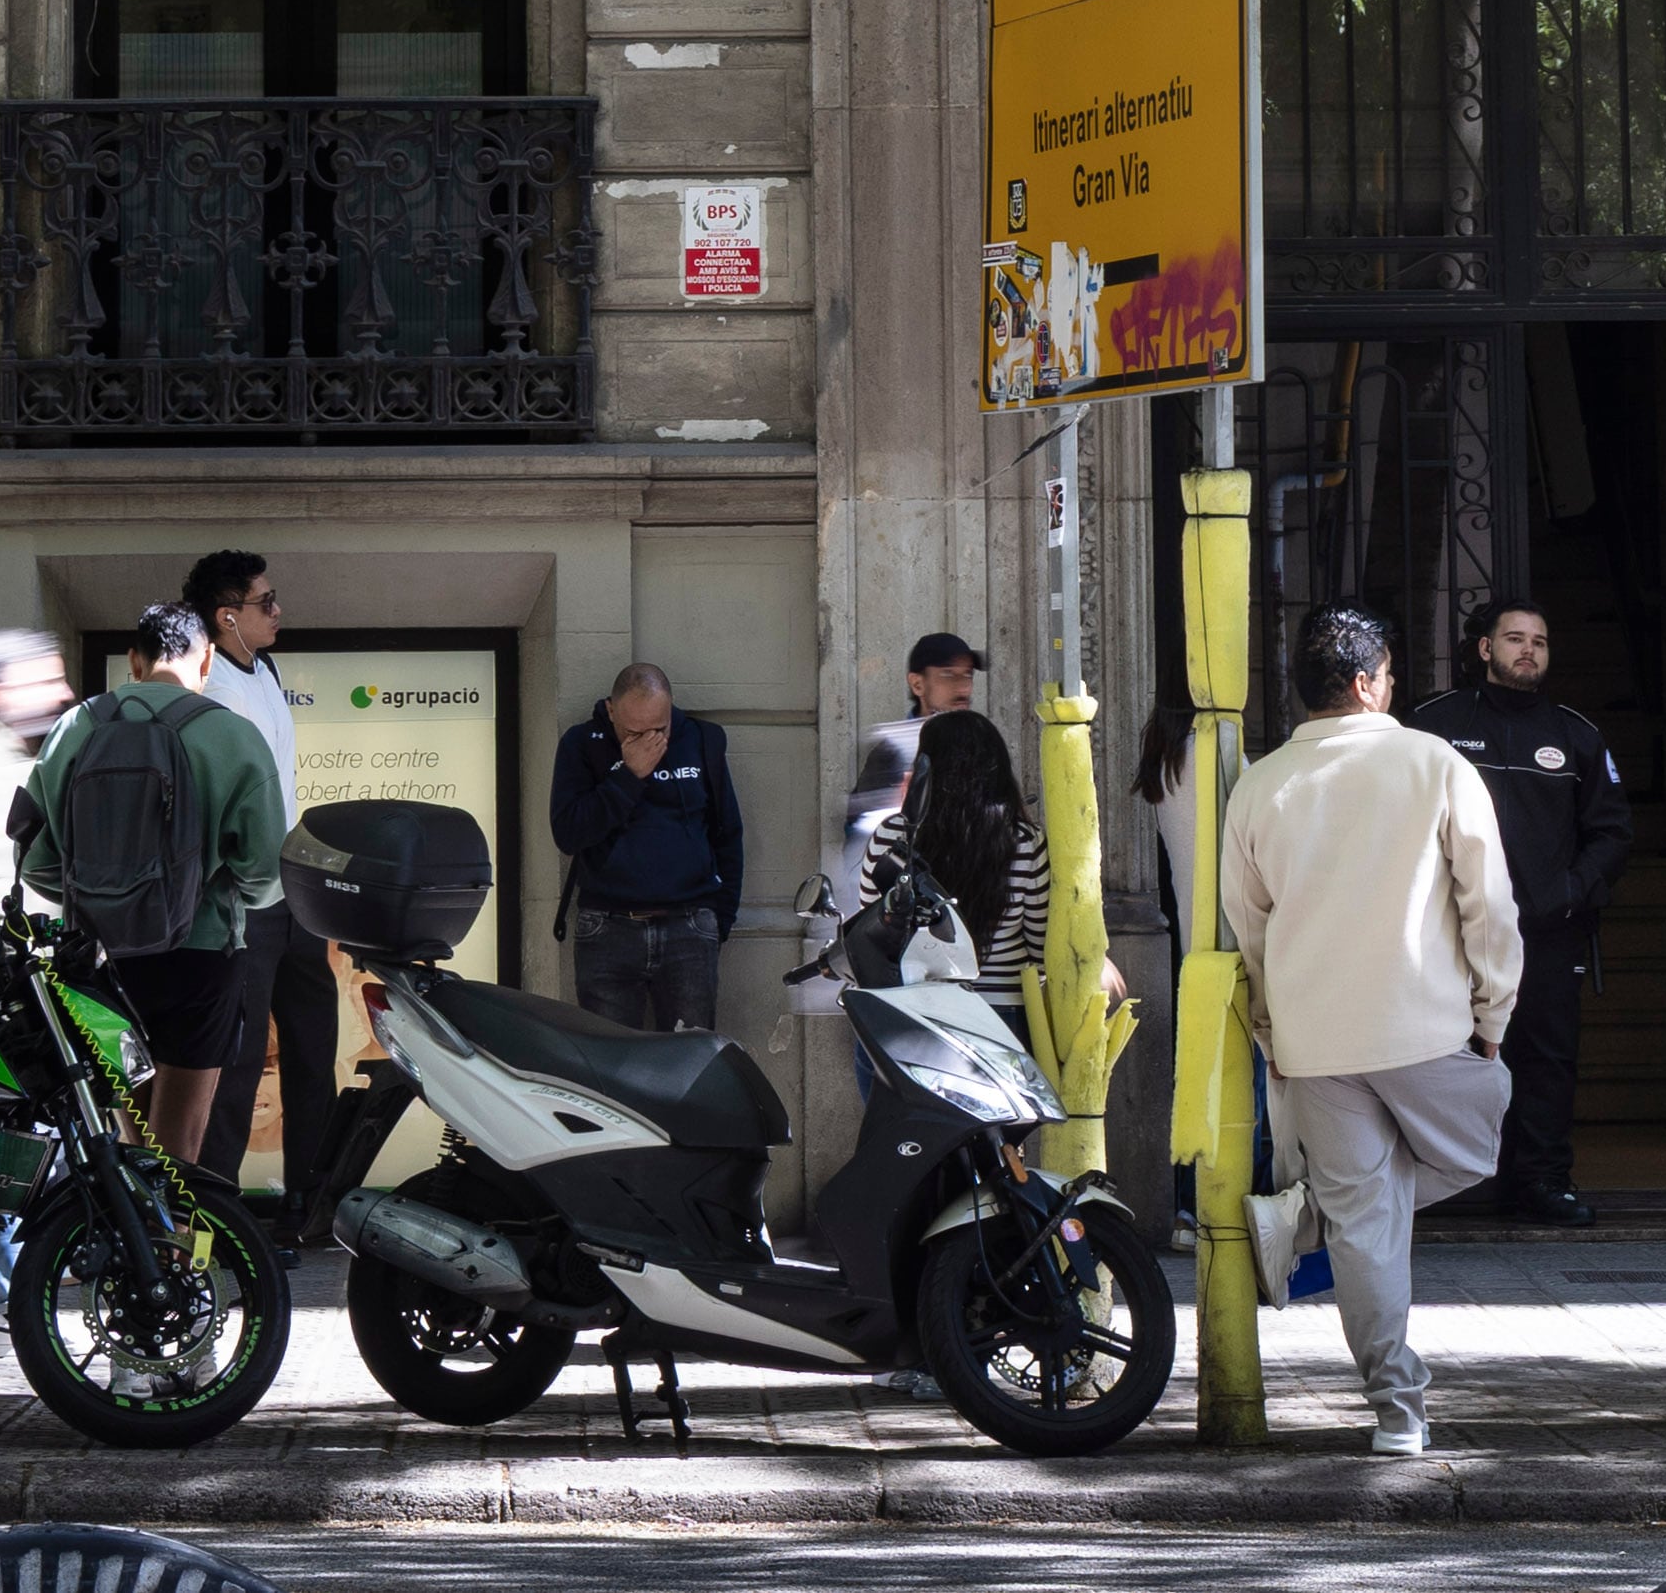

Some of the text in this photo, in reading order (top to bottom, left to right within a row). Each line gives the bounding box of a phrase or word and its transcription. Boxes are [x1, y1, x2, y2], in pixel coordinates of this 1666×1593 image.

[1033, 76, 1193, 154] Itinerari alternatiu
[1073, 163, 1115, 208] Gran
[1120, 152, 1150, 197] Via
[707, 205, 738, 219] BPS
[694, 238, 751, 247] 902 107 720
[693, 258, 751, 267] CONNECTADA
[705, 250, 741, 258] ALARMA
[740, 267, 747, 275] A
[381, 687, 480, 708] agrupació
[298, 748, 440, 769] vostre centre
[295, 779, 457, 802] obert a tothom
